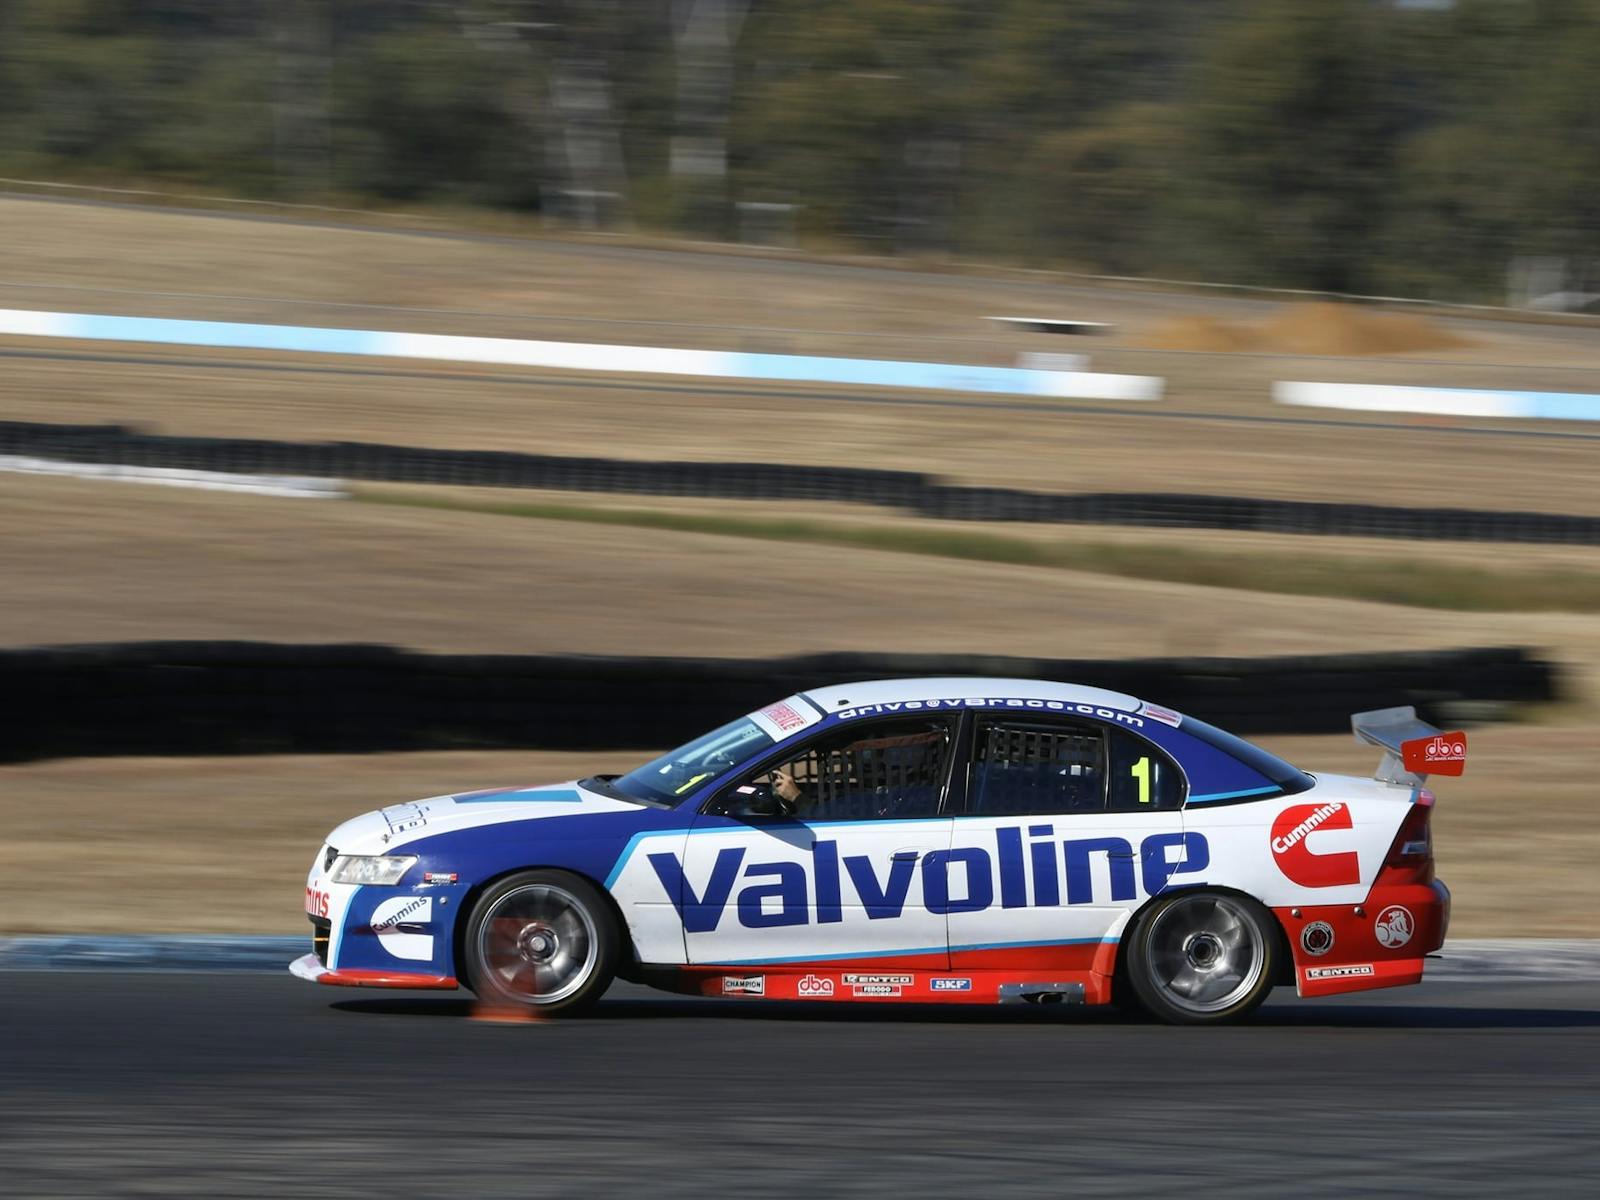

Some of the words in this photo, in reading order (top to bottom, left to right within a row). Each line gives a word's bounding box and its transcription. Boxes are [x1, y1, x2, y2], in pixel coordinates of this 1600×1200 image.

[1425, 737, 1466, 756] dba
[1132, 757, 1149, 802] 1
[1271, 800, 1342, 854] Cummins
[647, 824, 1210, 933] Valvoline
[373, 895, 427, 931] Cummins
[725, 980, 761, 988] CHAMPION
[799, 976, 832, 991] dba
[934, 980, 967, 989] SKF
